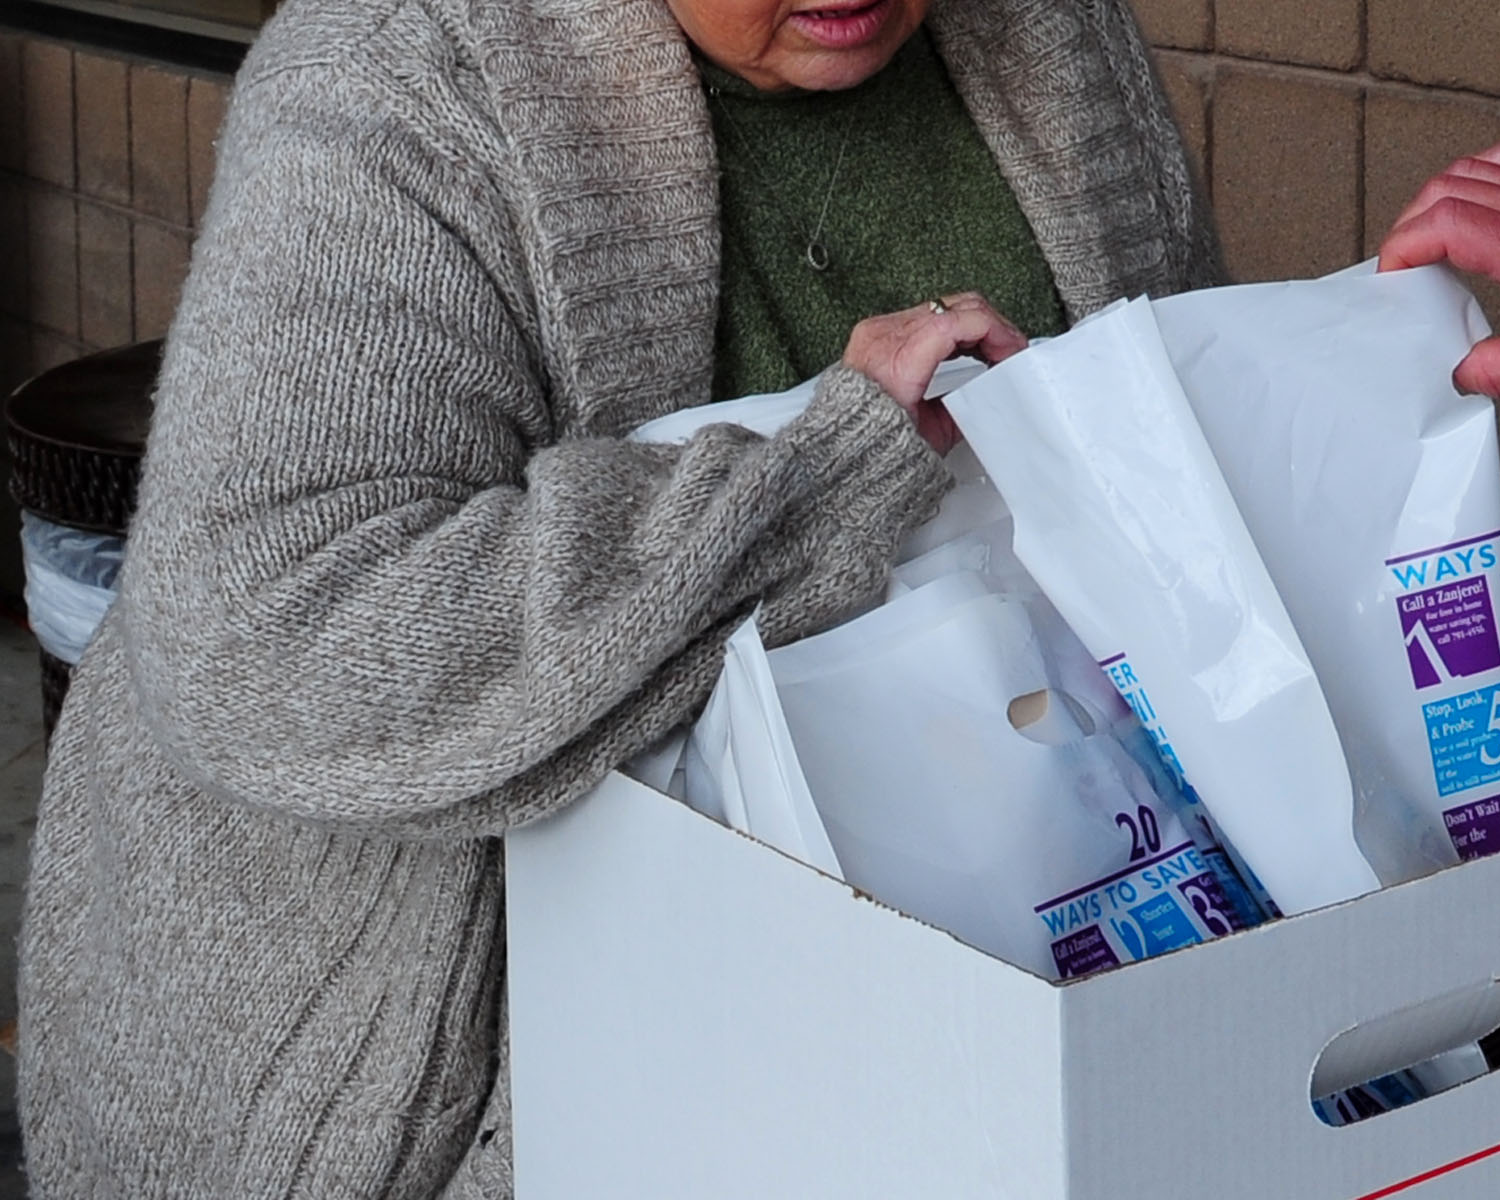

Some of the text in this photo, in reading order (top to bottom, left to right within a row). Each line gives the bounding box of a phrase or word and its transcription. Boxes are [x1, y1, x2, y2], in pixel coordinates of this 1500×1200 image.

[1392, 544, 1496, 590] WAYS
[1402, 579, 1485, 613] Call a Zanjero!
[1106, 662, 1138, 689] ER
[1431, 717, 1475, 740] & Probe
[1445, 800, 1500, 828] Don't Wait
[1115, 804, 1161, 862] 20
[1469, 827, 1488, 843] the
[1041, 893, 1102, 937] WAYS
[1104, 881, 1137, 910] TO
[1142, 849, 1204, 890] SAVE
[1140, 898, 1175, 922] Shorten
